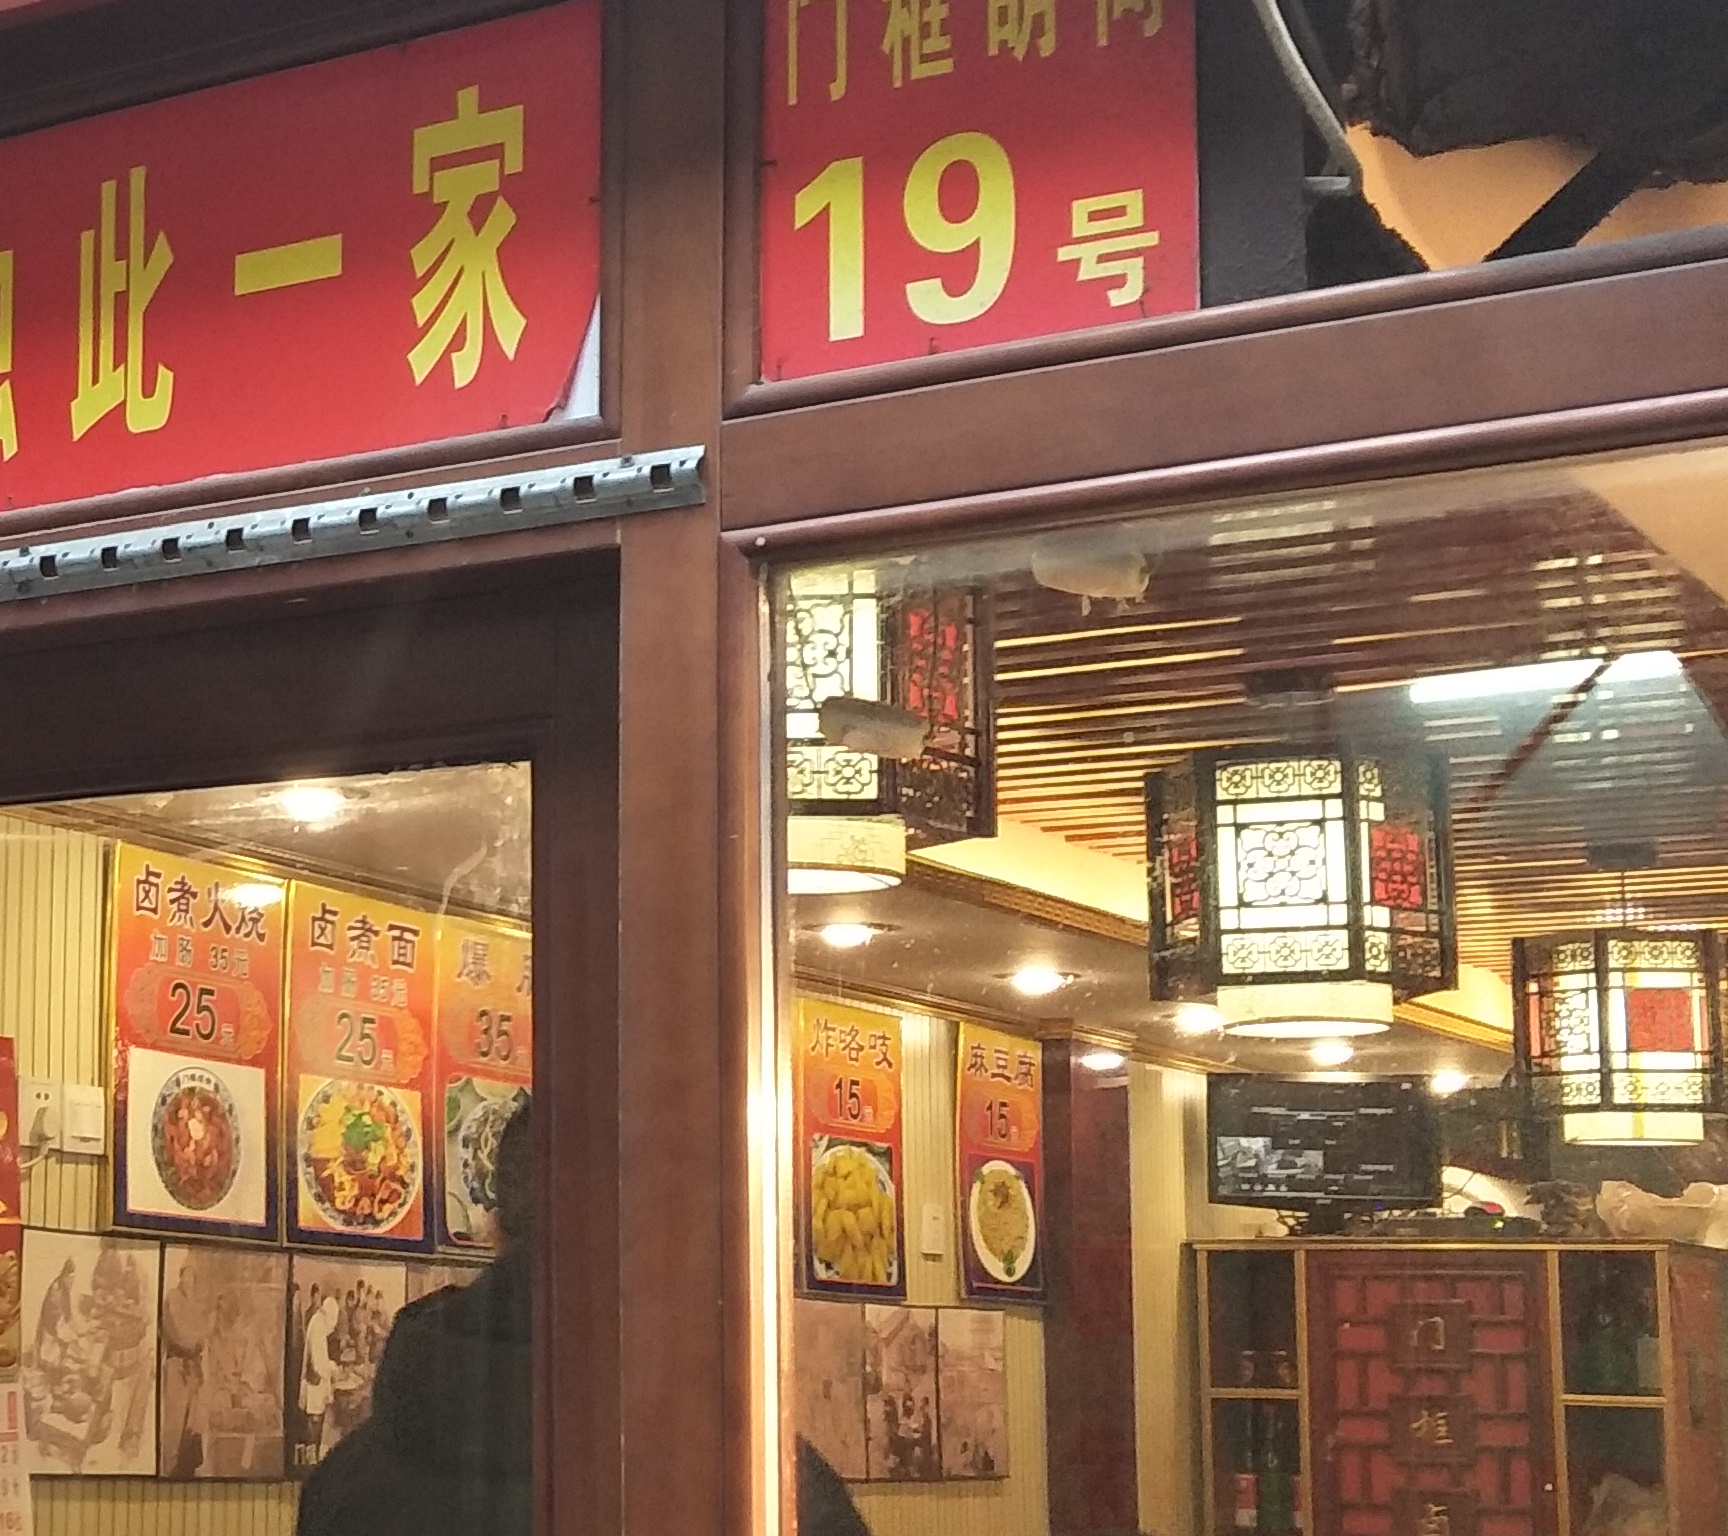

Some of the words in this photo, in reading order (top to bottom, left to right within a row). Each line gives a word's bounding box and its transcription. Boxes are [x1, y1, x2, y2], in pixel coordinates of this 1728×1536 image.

[794, 131, 1161, 342] 19号
[309, 902, 420, 972] 卤煮面
[810, 1017, 894, 1070] 炸咯吱
[966, 1043, 1036, 1090] 麻豆腐
